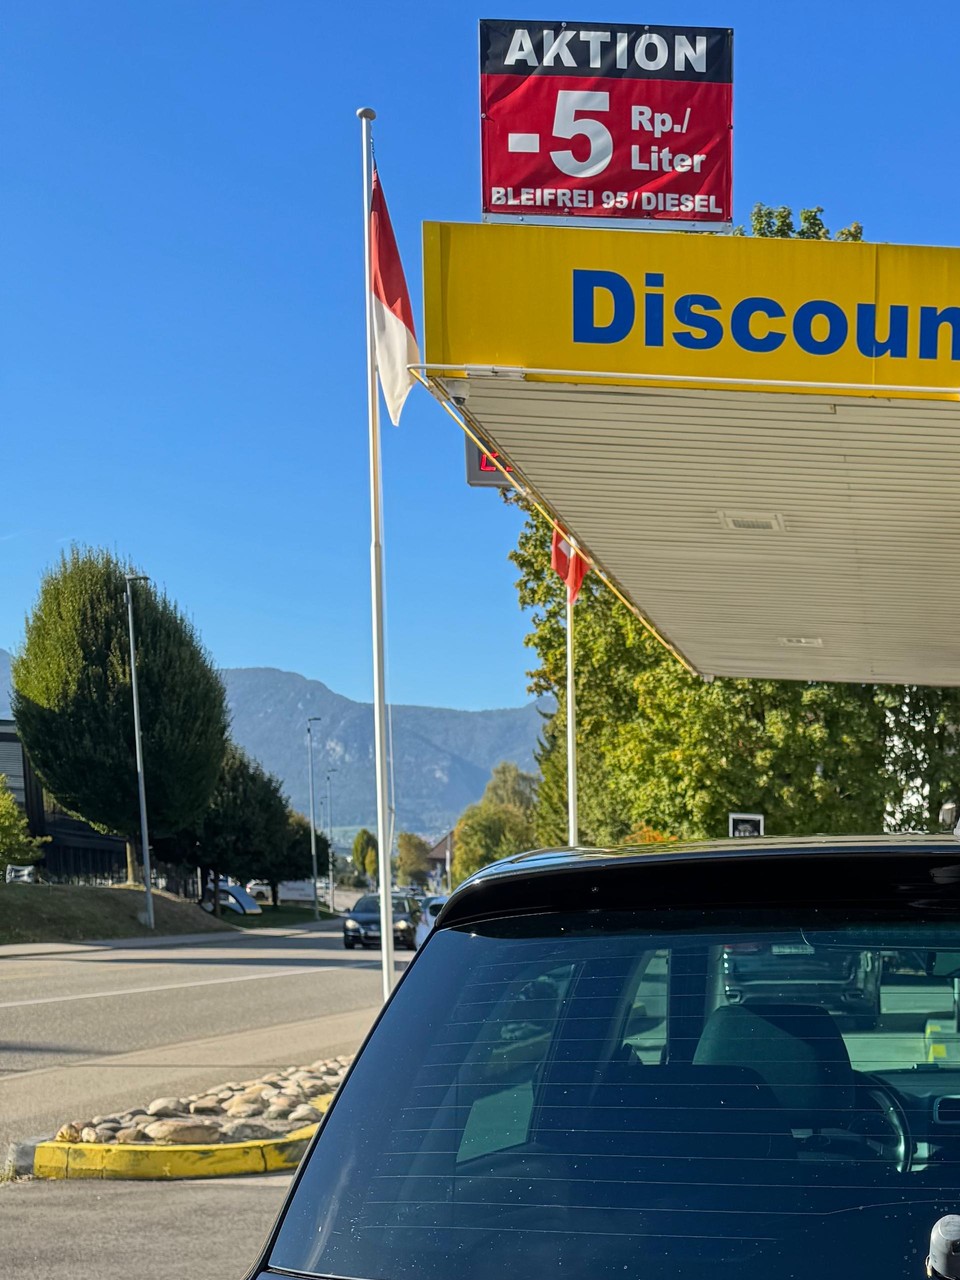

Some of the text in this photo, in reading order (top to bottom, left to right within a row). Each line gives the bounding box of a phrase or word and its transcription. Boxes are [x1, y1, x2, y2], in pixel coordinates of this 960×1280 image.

[504, 29, 707, 73] AKTION
[508, 90, 691, 178] -5 Rp./
[631, 145, 706, 173] Liter
[491, 187, 594, 208] BLEIFREI
